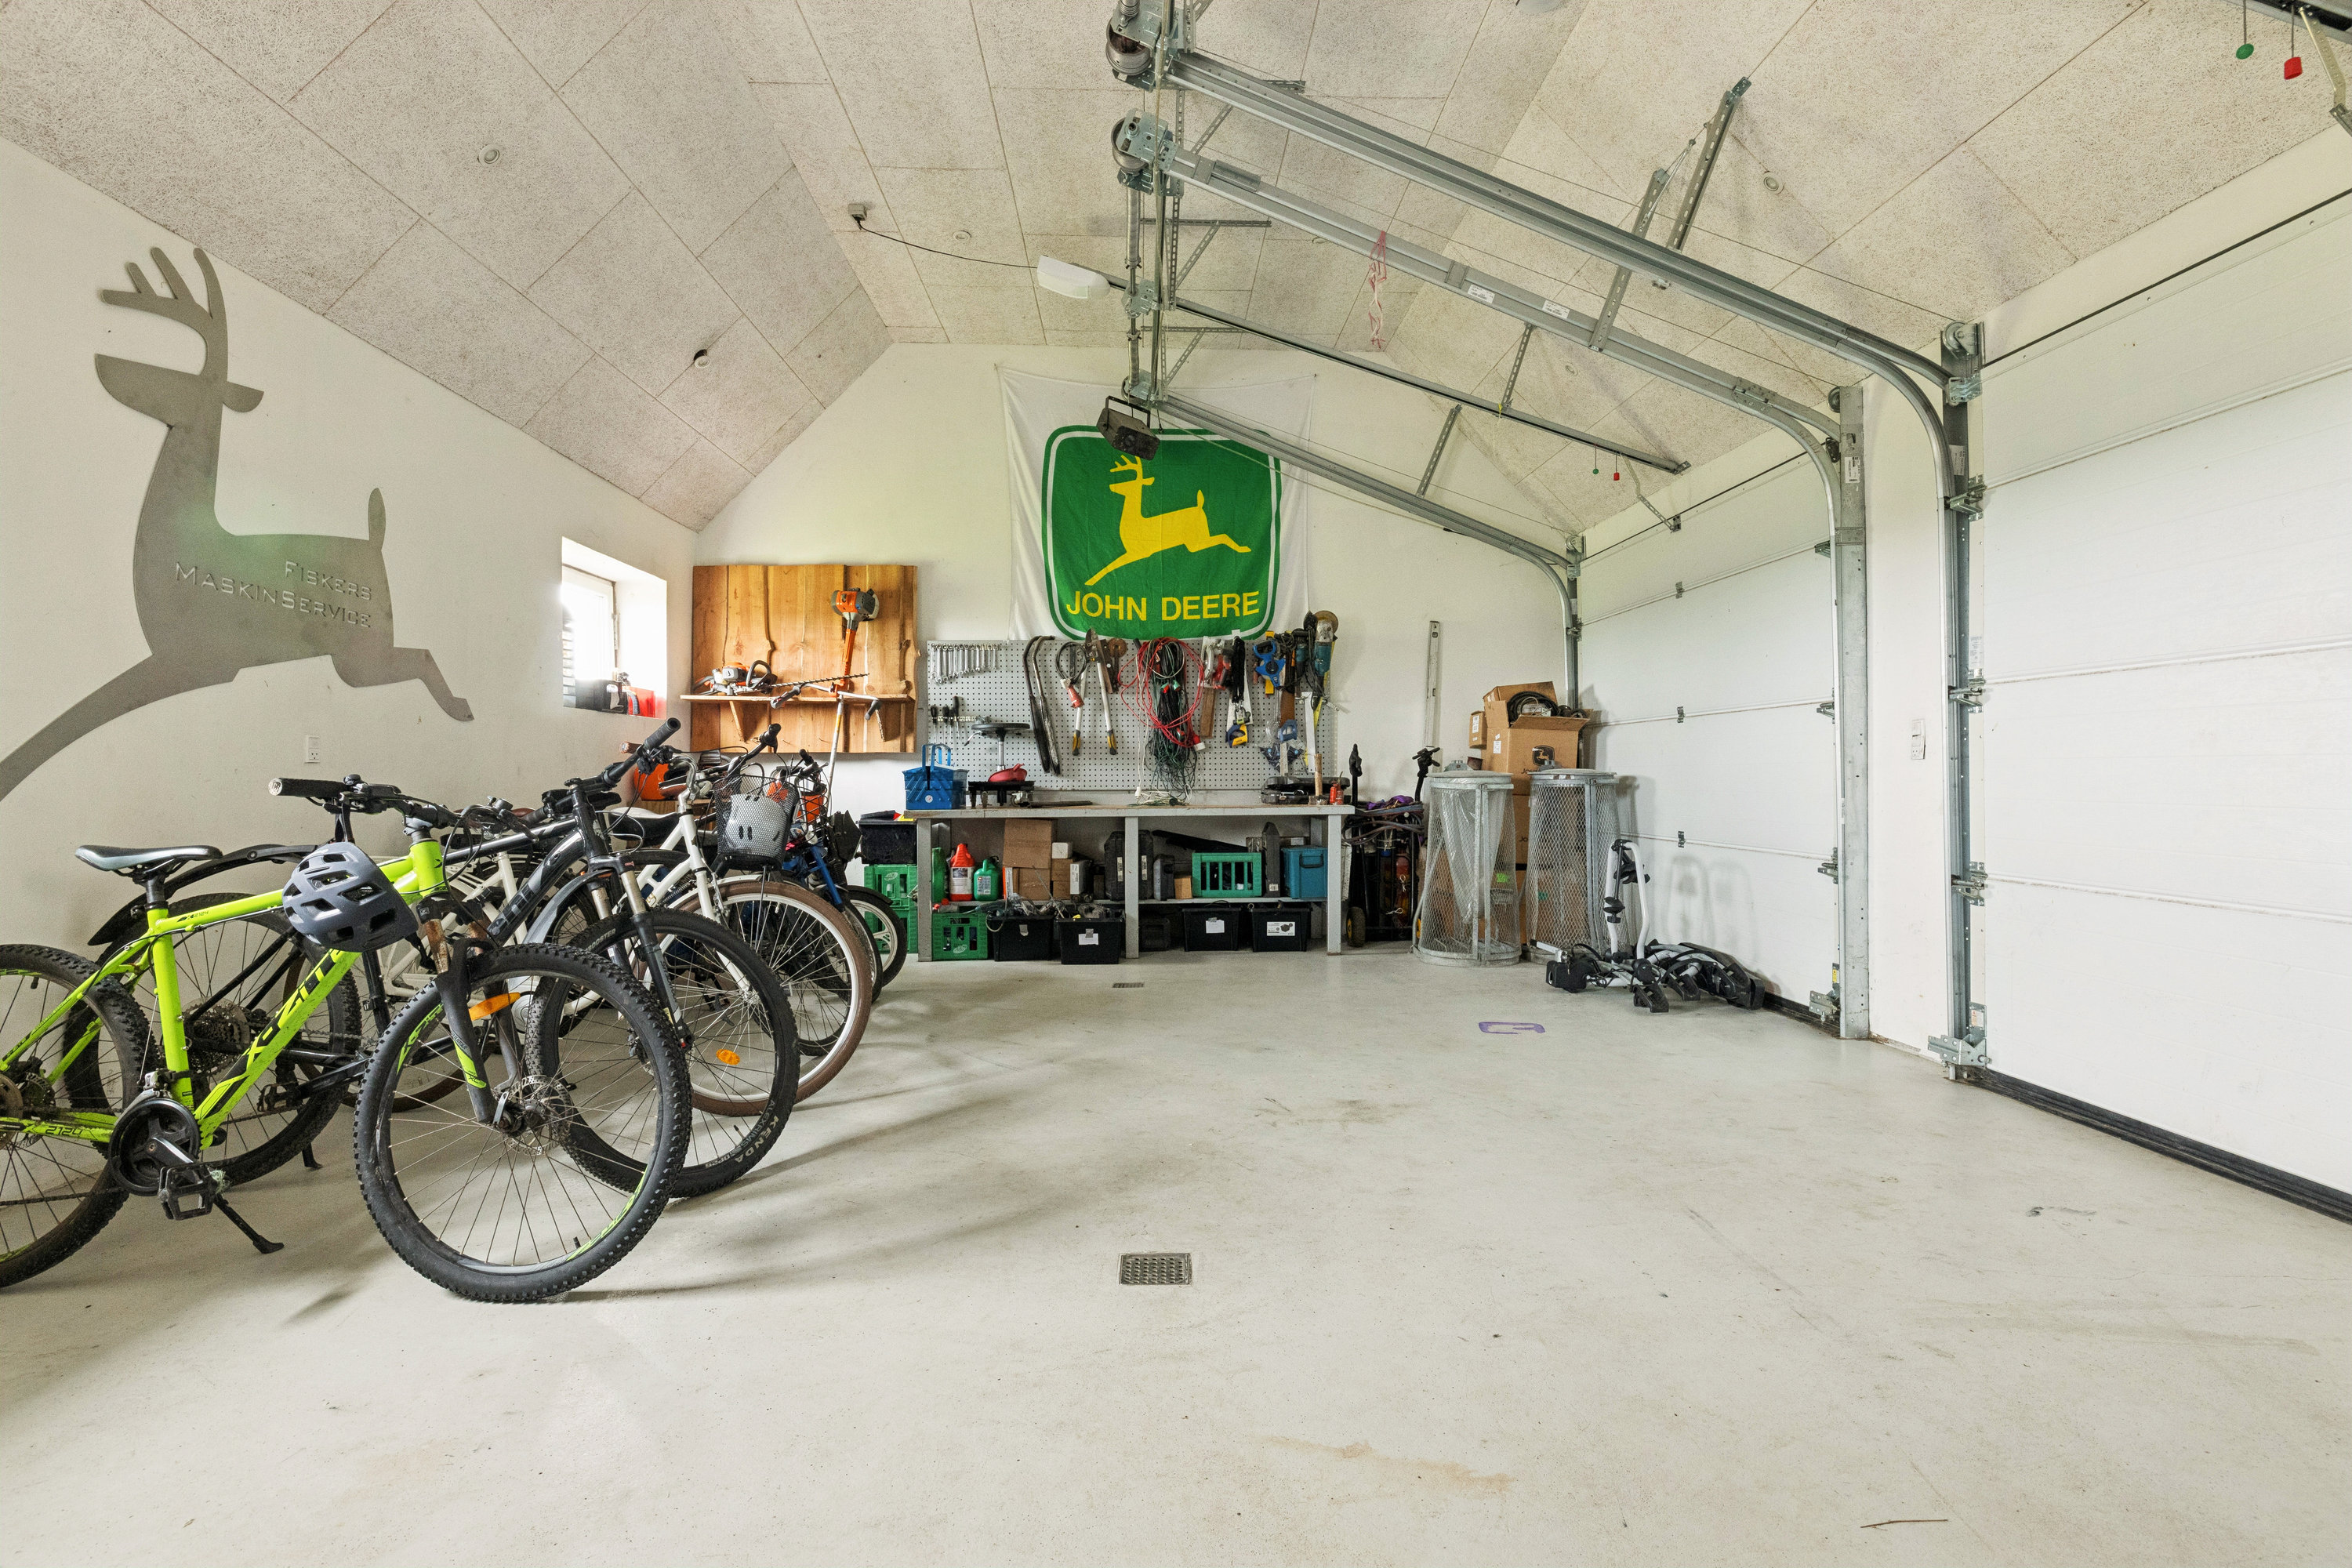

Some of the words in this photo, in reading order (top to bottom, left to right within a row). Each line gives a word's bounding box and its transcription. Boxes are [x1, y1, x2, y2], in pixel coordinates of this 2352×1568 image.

[1066, 590, 1147, 622] JOHN
[1161, 590, 1260, 621] DEERE
[735, 1115, 779, 1163] KENDA
